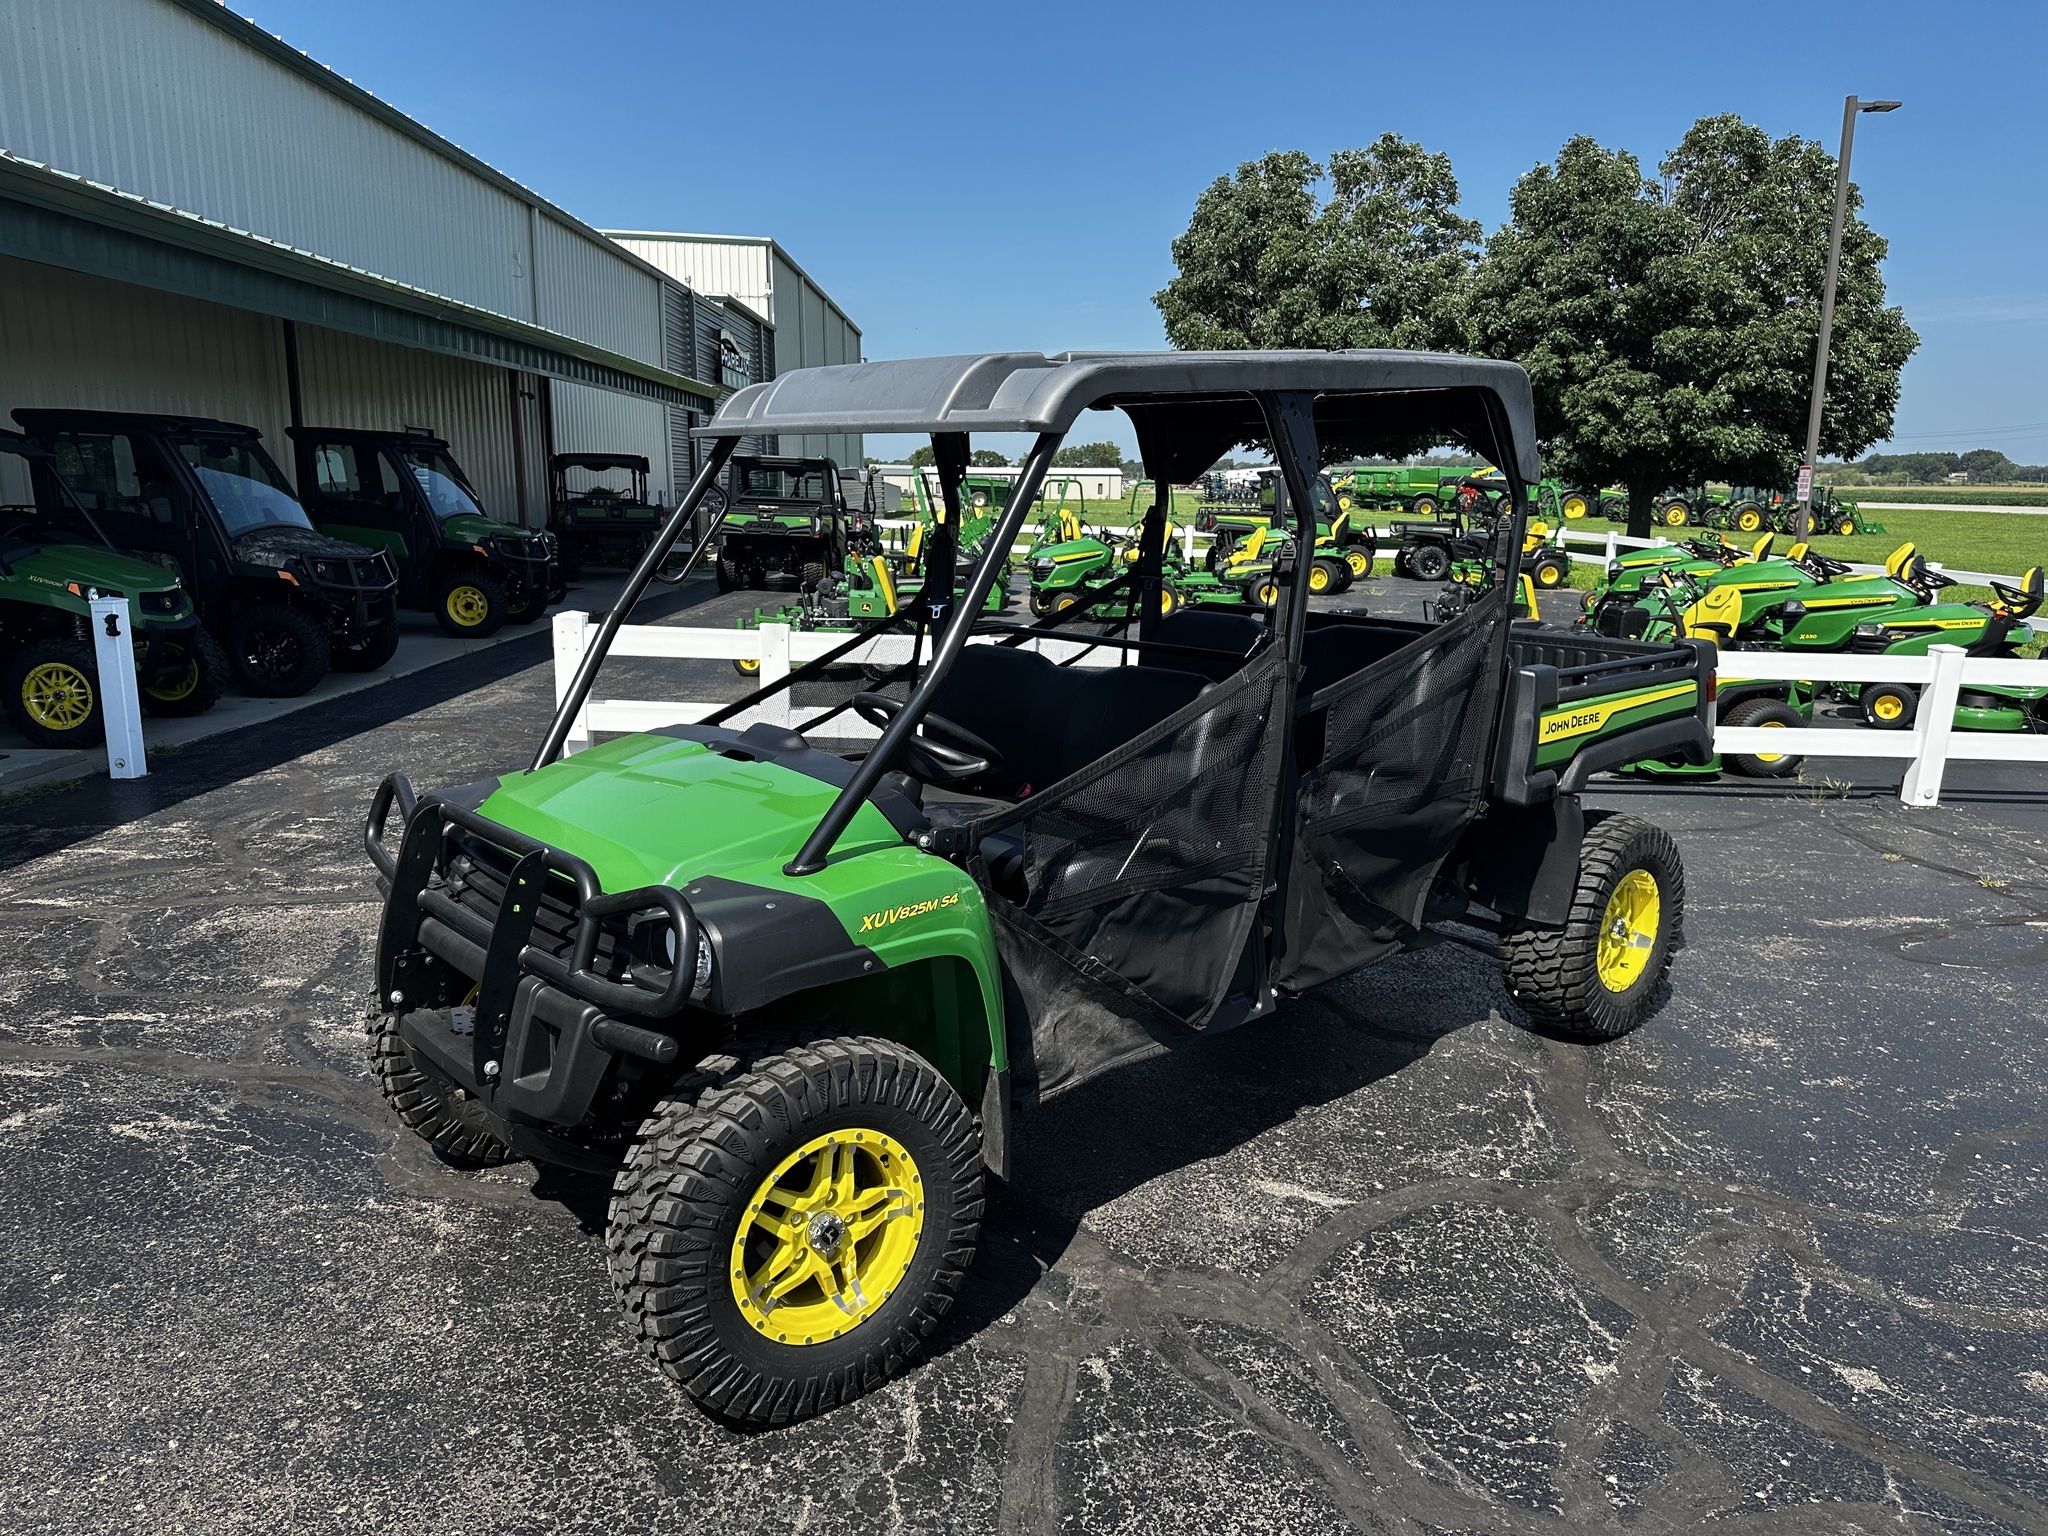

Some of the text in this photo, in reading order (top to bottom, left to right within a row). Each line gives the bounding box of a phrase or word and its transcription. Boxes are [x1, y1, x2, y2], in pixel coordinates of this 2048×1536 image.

[1545, 712, 1600, 735] JOHN DEERE
[858, 892, 960, 934] XUV825M S4
